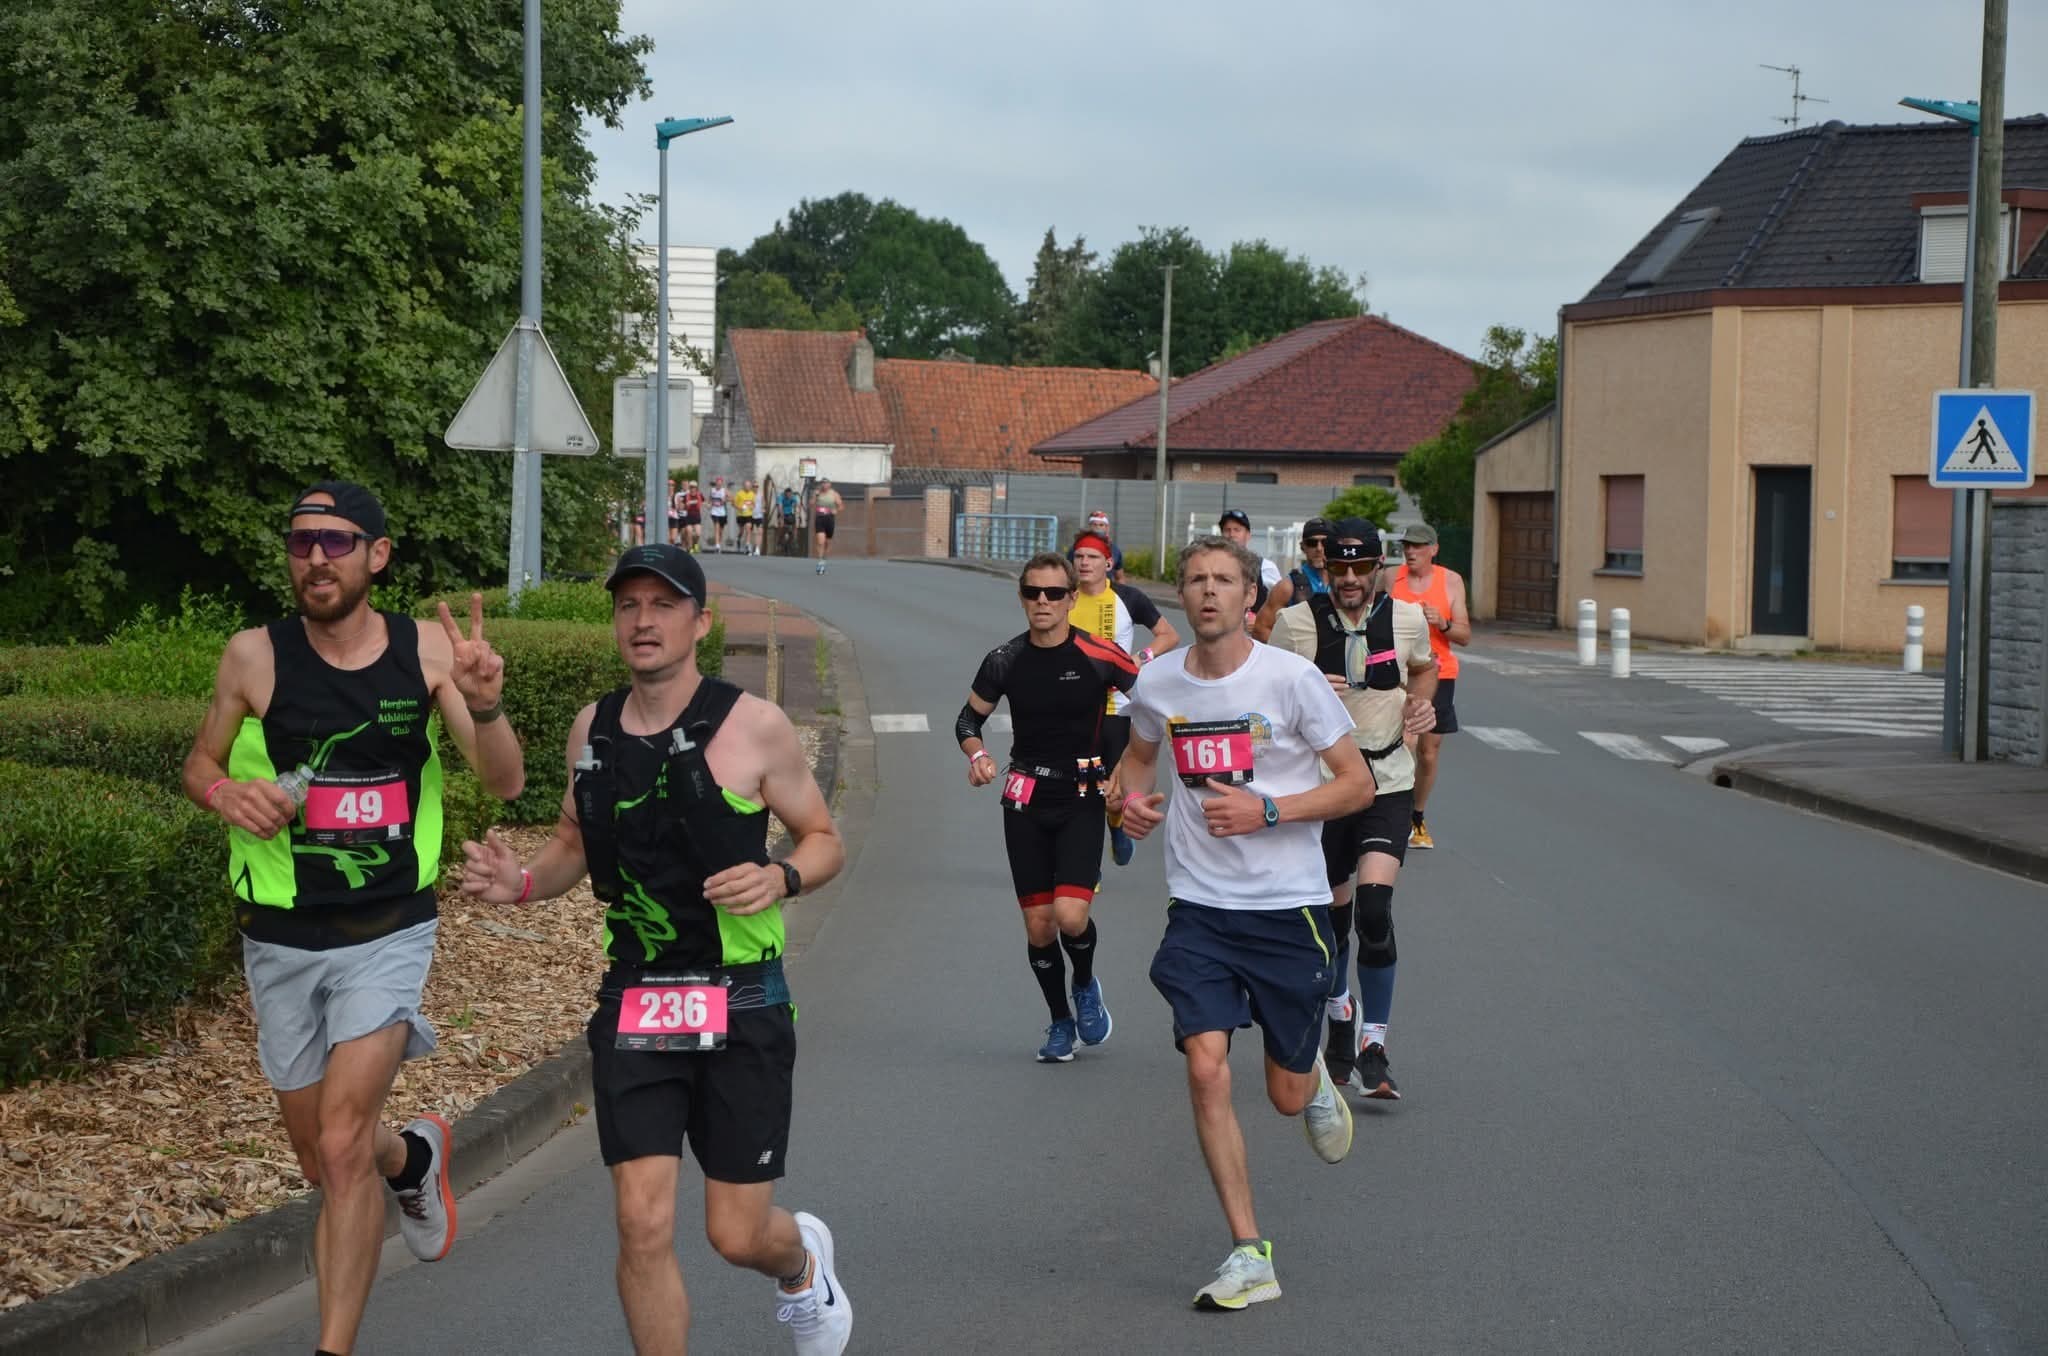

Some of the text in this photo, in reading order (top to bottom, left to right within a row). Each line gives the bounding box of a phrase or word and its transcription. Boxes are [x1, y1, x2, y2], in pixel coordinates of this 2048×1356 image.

[1182, 738, 1232, 769] 161
[335, 790, 383, 824] 49
[638, 990, 708, 1029] 236
